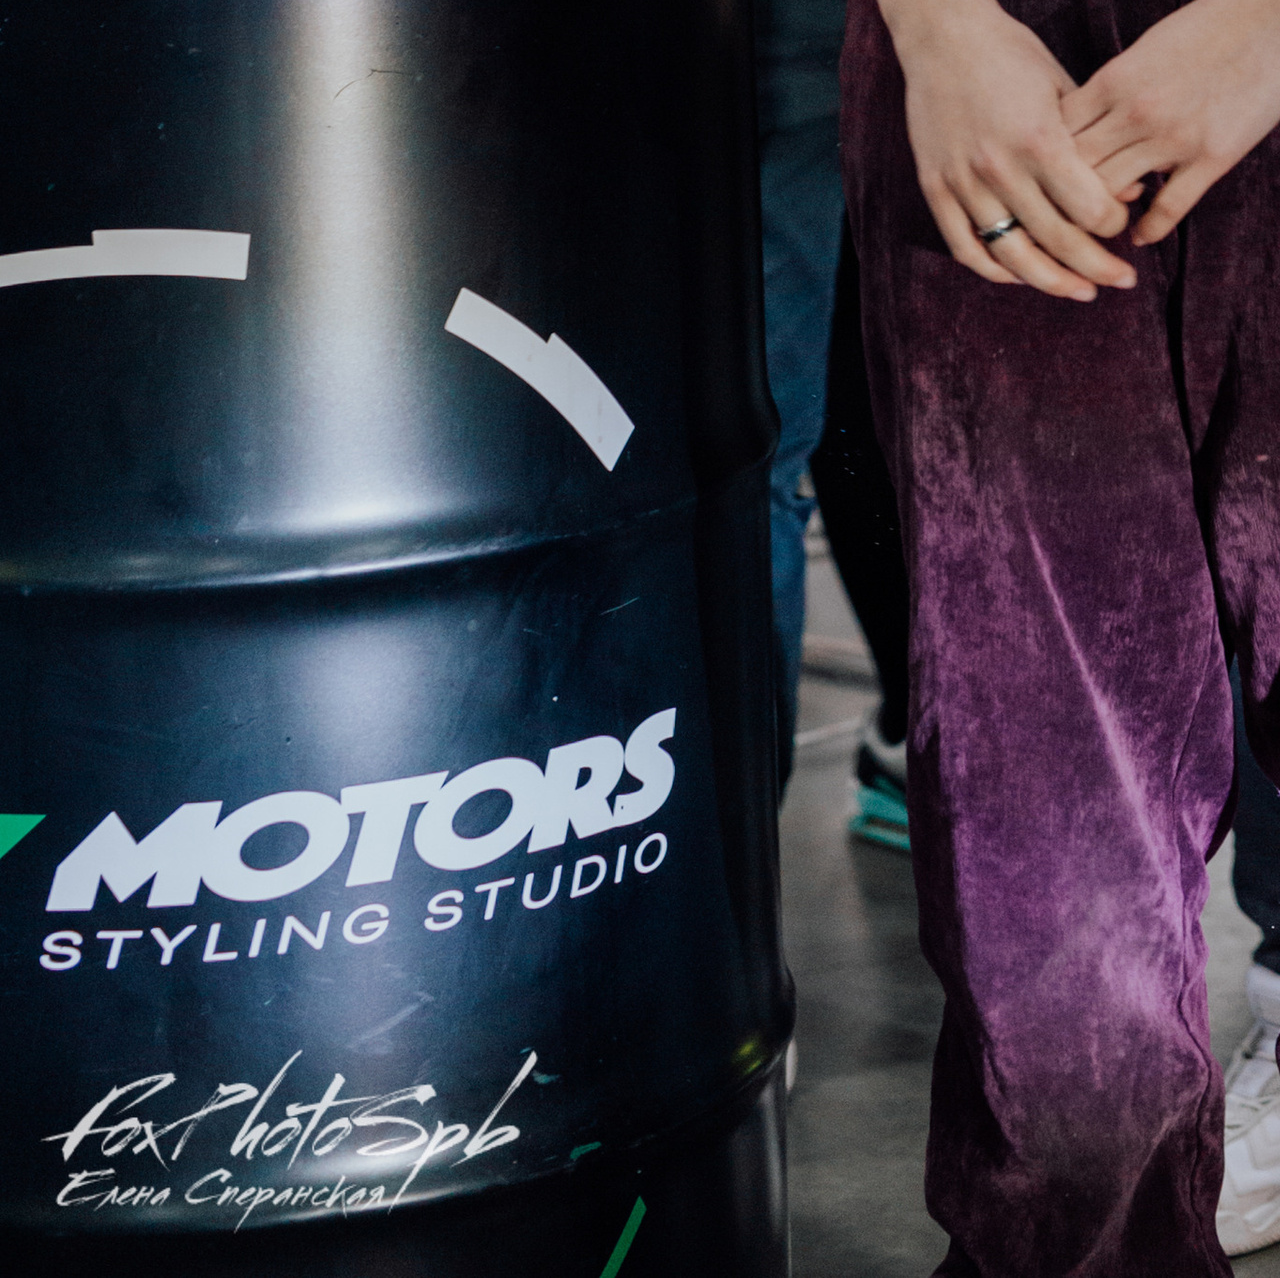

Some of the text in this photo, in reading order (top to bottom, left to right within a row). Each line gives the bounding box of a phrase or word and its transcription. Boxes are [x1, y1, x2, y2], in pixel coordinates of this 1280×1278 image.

[45, 707, 677, 912] MOTORS
[39, 832, 669, 971] STYLING STUDIO
